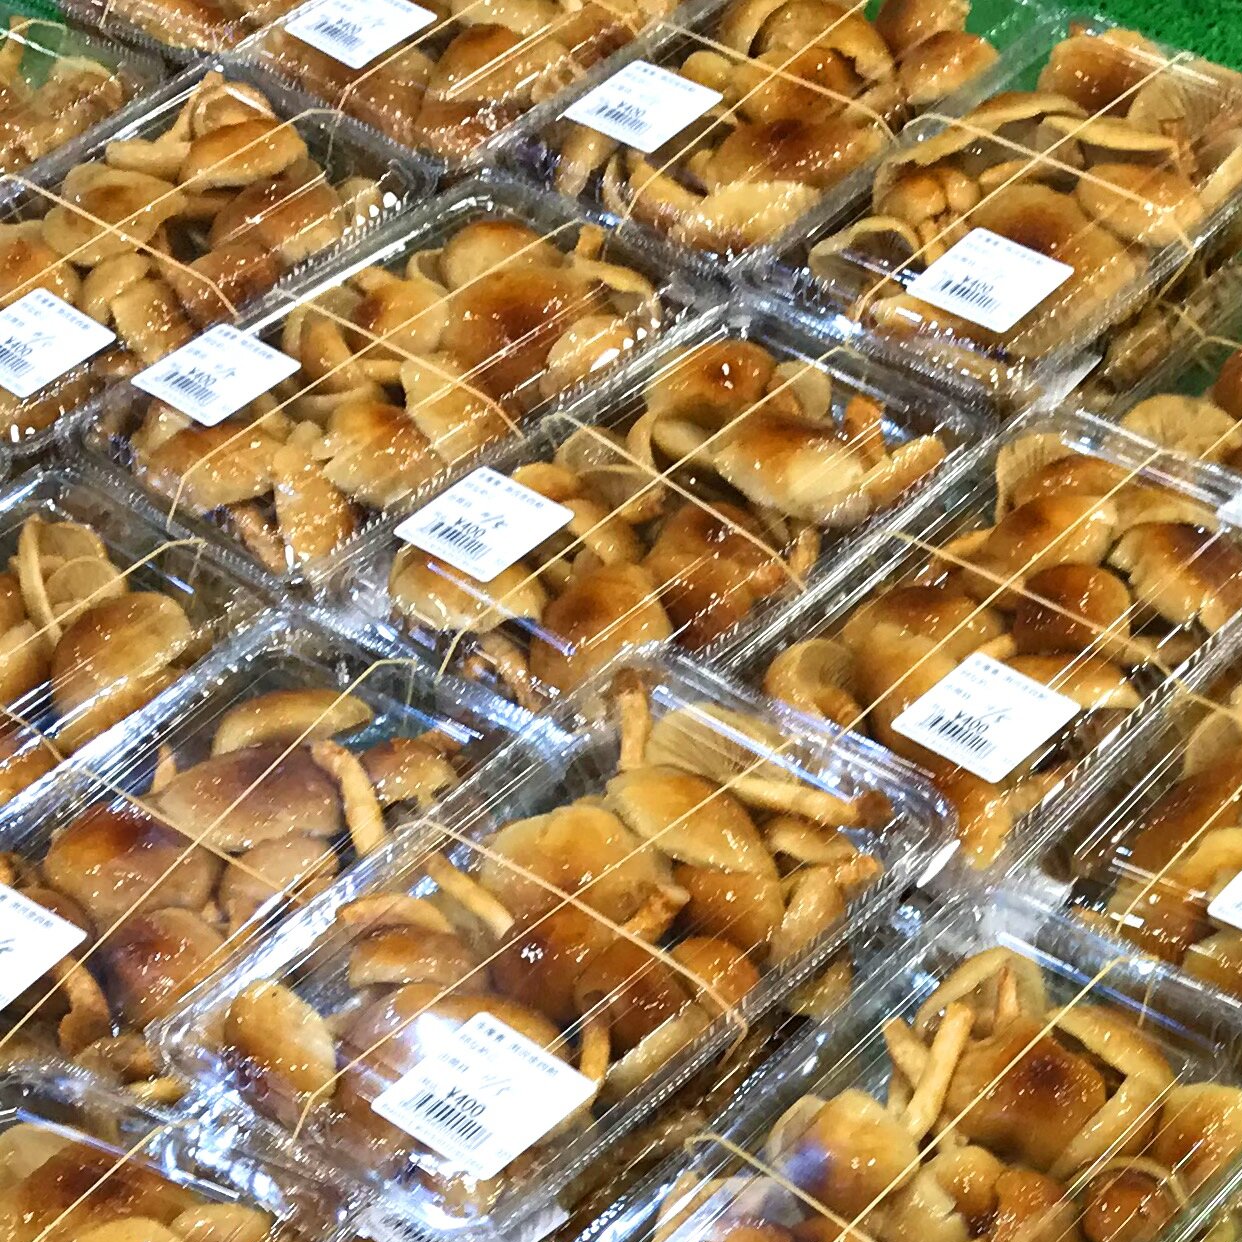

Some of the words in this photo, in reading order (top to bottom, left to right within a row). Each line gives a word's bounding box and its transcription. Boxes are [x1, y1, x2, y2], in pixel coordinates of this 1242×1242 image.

[453, 516, 487, 539] ¥400
[953, 710, 990, 736] ¥400
[440, 1085, 489, 1119] ¥400
